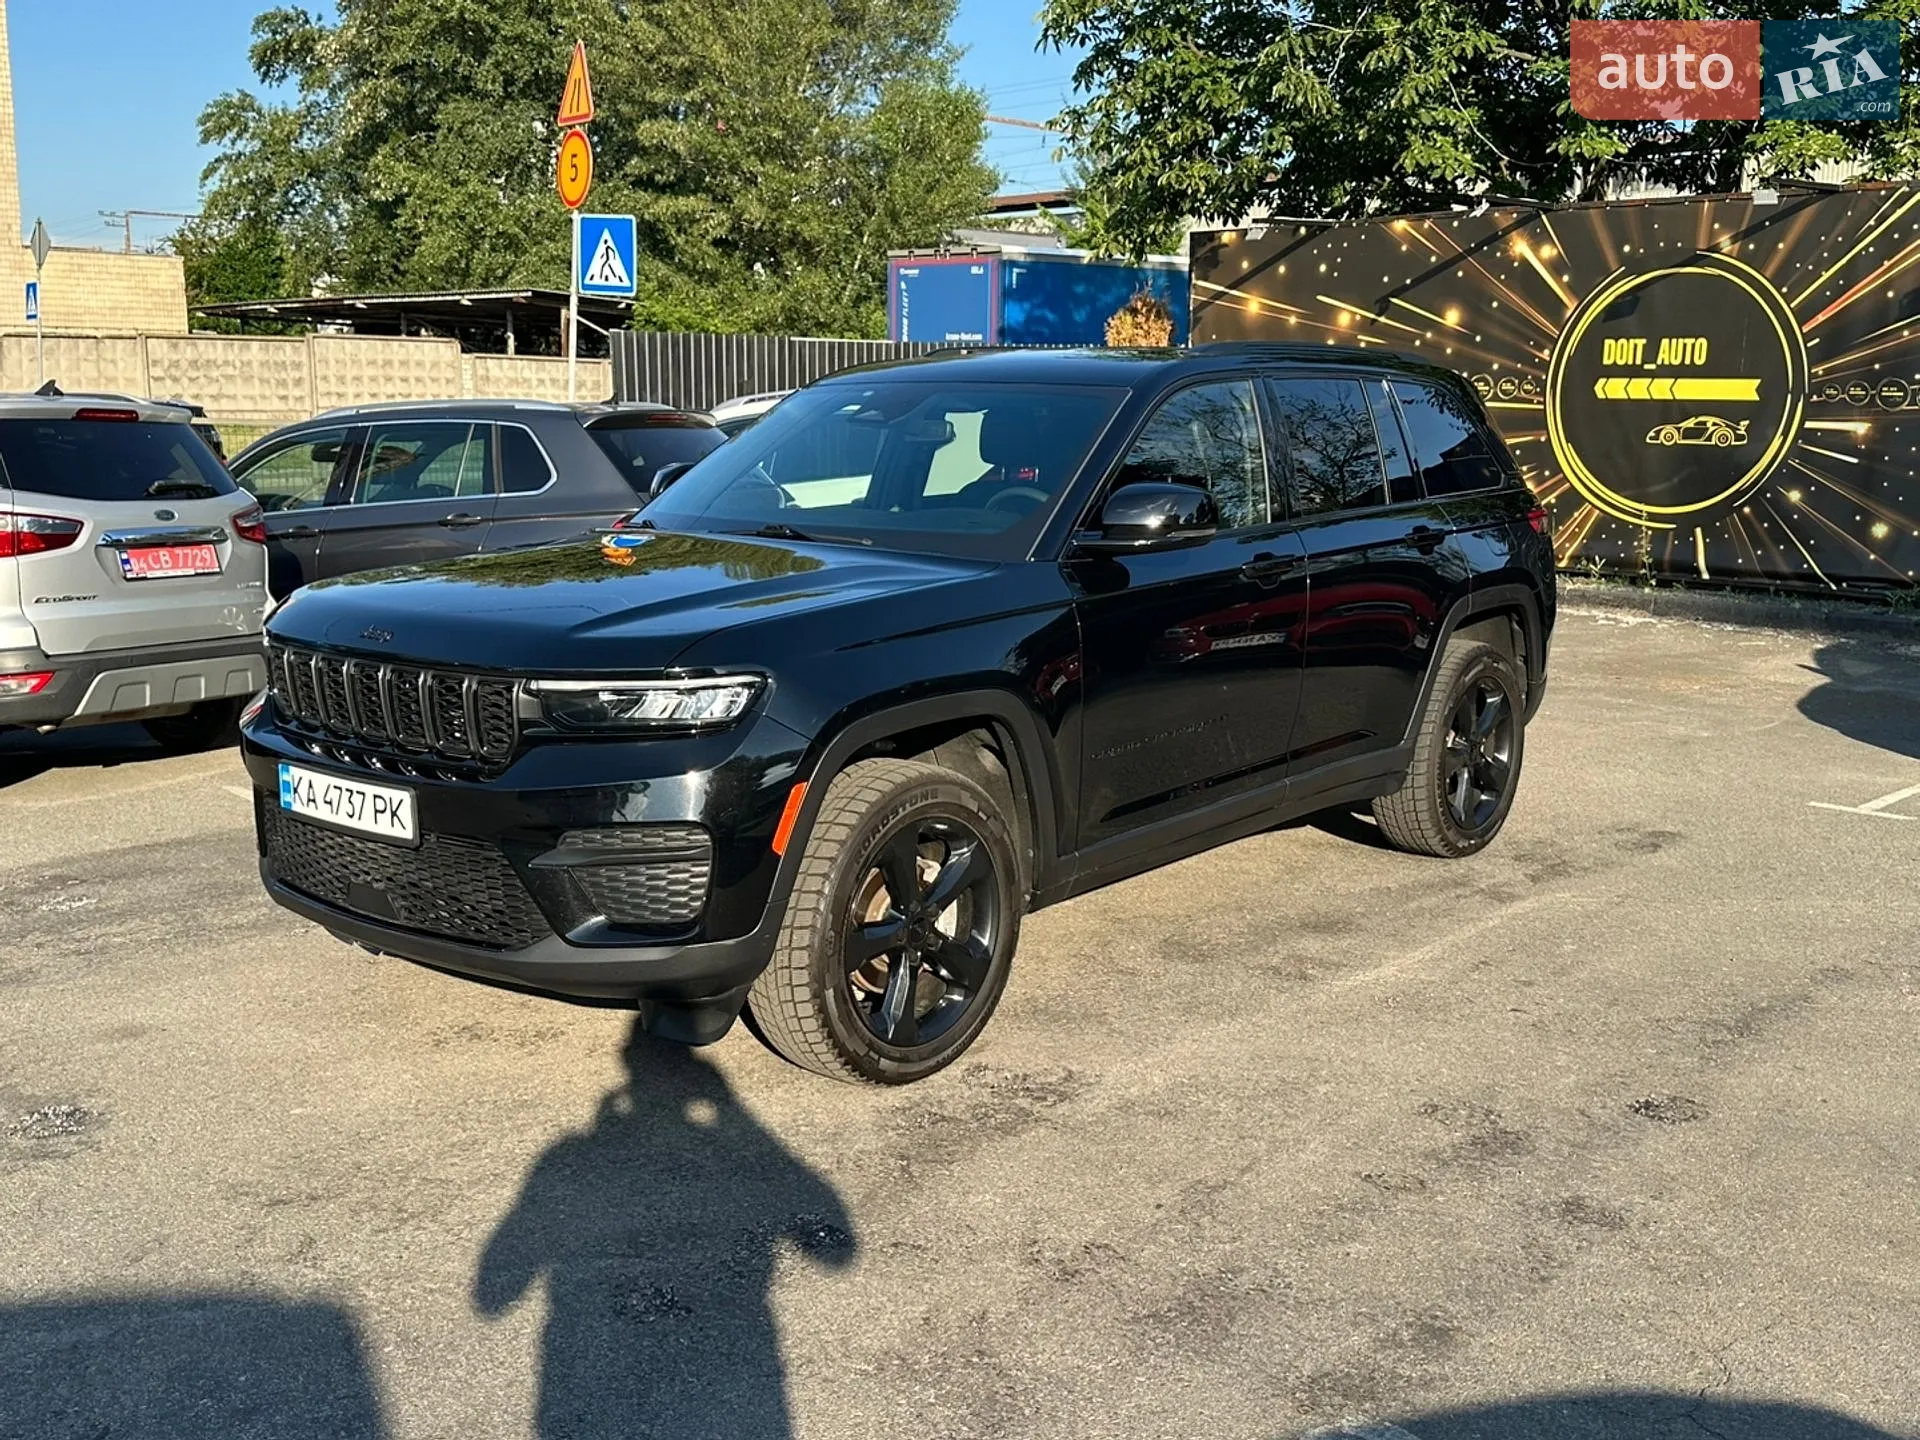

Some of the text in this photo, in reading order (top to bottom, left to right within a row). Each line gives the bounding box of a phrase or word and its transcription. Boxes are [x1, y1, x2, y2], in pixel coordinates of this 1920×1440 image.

[570, 153, 578, 182] 5
[1602, 337, 1708, 370] DOIT_AUTO
[148, 550, 173, 569] CB
[175, 548, 212, 568] 7729
[291, 774, 407, 831] KA 4737 PK
